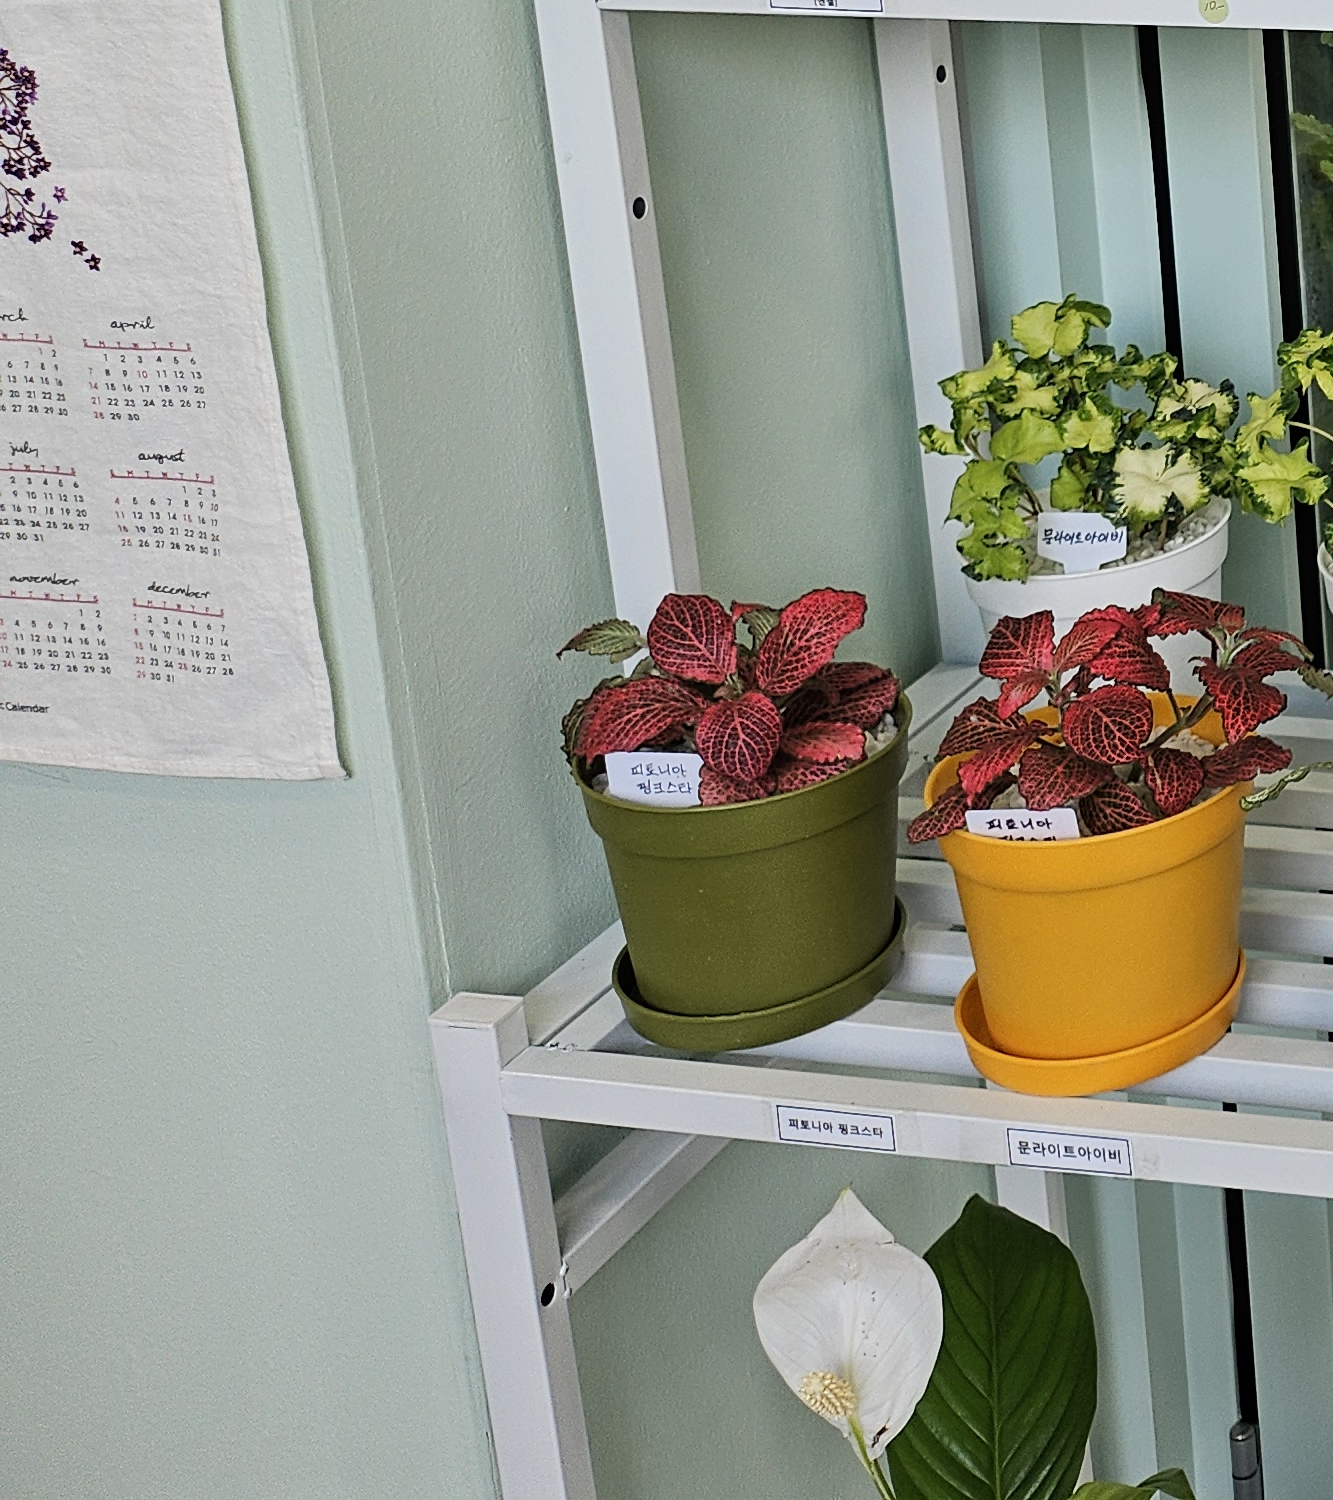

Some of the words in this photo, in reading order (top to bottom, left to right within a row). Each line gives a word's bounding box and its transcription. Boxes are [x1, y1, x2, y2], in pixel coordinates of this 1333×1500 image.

[110, 315, 155, 332] april
[120, 355, 126, 363] 2
[137, 356, 143, 364] 3
[173, 357, 179, 365] 5
[190, 357, 197, 365] 6
[137, 370, 148, 379] 10
[156, 370, 167, 378] 11
[173, 370, 185, 379] 12
[191, 371, 202, 379] 13
[105, 383, 116, 391] 15
[122, 384, 133, 392] 16
[139, 385, 150, 393] 17
[159, 385, 170, 393] 18
[177, 385, 188, 393] 19
[194, 386, 205, 394] 20
[107, 398, 119, 406] 22
[124, 399, 136, 407] 23
[142, 399, 155, 407] 24
[161, 399, 174, 407] 25
[180, 399, 191, 407] 26
[196, 400, 206, 409] 27
[110, 412, 121, 420] 29
[128, 413, 140, 421] 30
[8, 441, 39, 458] july
[138, 448, 186, 465] august
[1042, 526, 1123, 546] 문라이트아이비
[9, 573, 80, 586] november
[147, 581, 211, 599] december
[6, 701, 50, 714] Calendar
[631, 762, 687, 778] 피토니아
[637, 780, 693, 795] 핑크스타
[985, 817, 1053, 831] 피토니아
[788, 1118, 834, 1134] 피토니아
[838, 1122, 885, 1139] 핑크스타
[1017, 1140, 1123, 1165] 문라이트아이비
